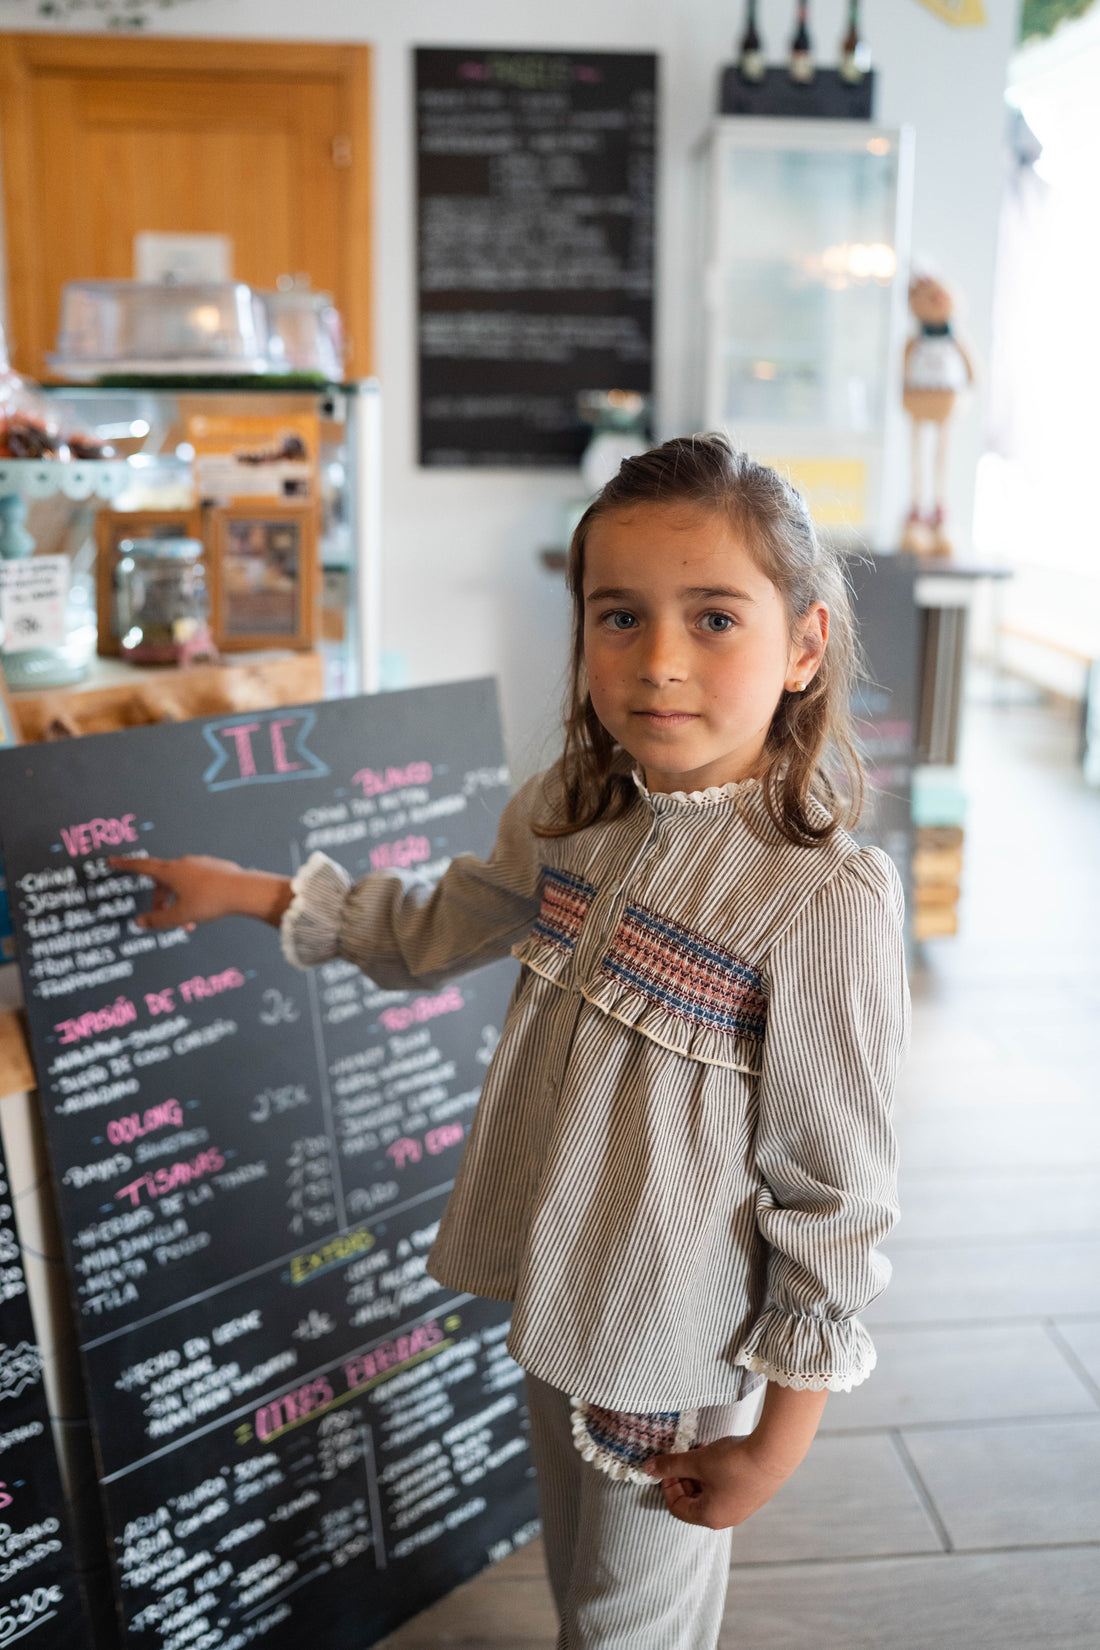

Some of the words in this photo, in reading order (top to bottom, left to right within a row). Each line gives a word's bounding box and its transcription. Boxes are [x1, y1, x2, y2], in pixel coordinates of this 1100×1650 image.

[60, 813, 138, 857] VERDE
[144, 988, 176, 1016] DE
[107, 1098, 183, 1145] OOLONG
